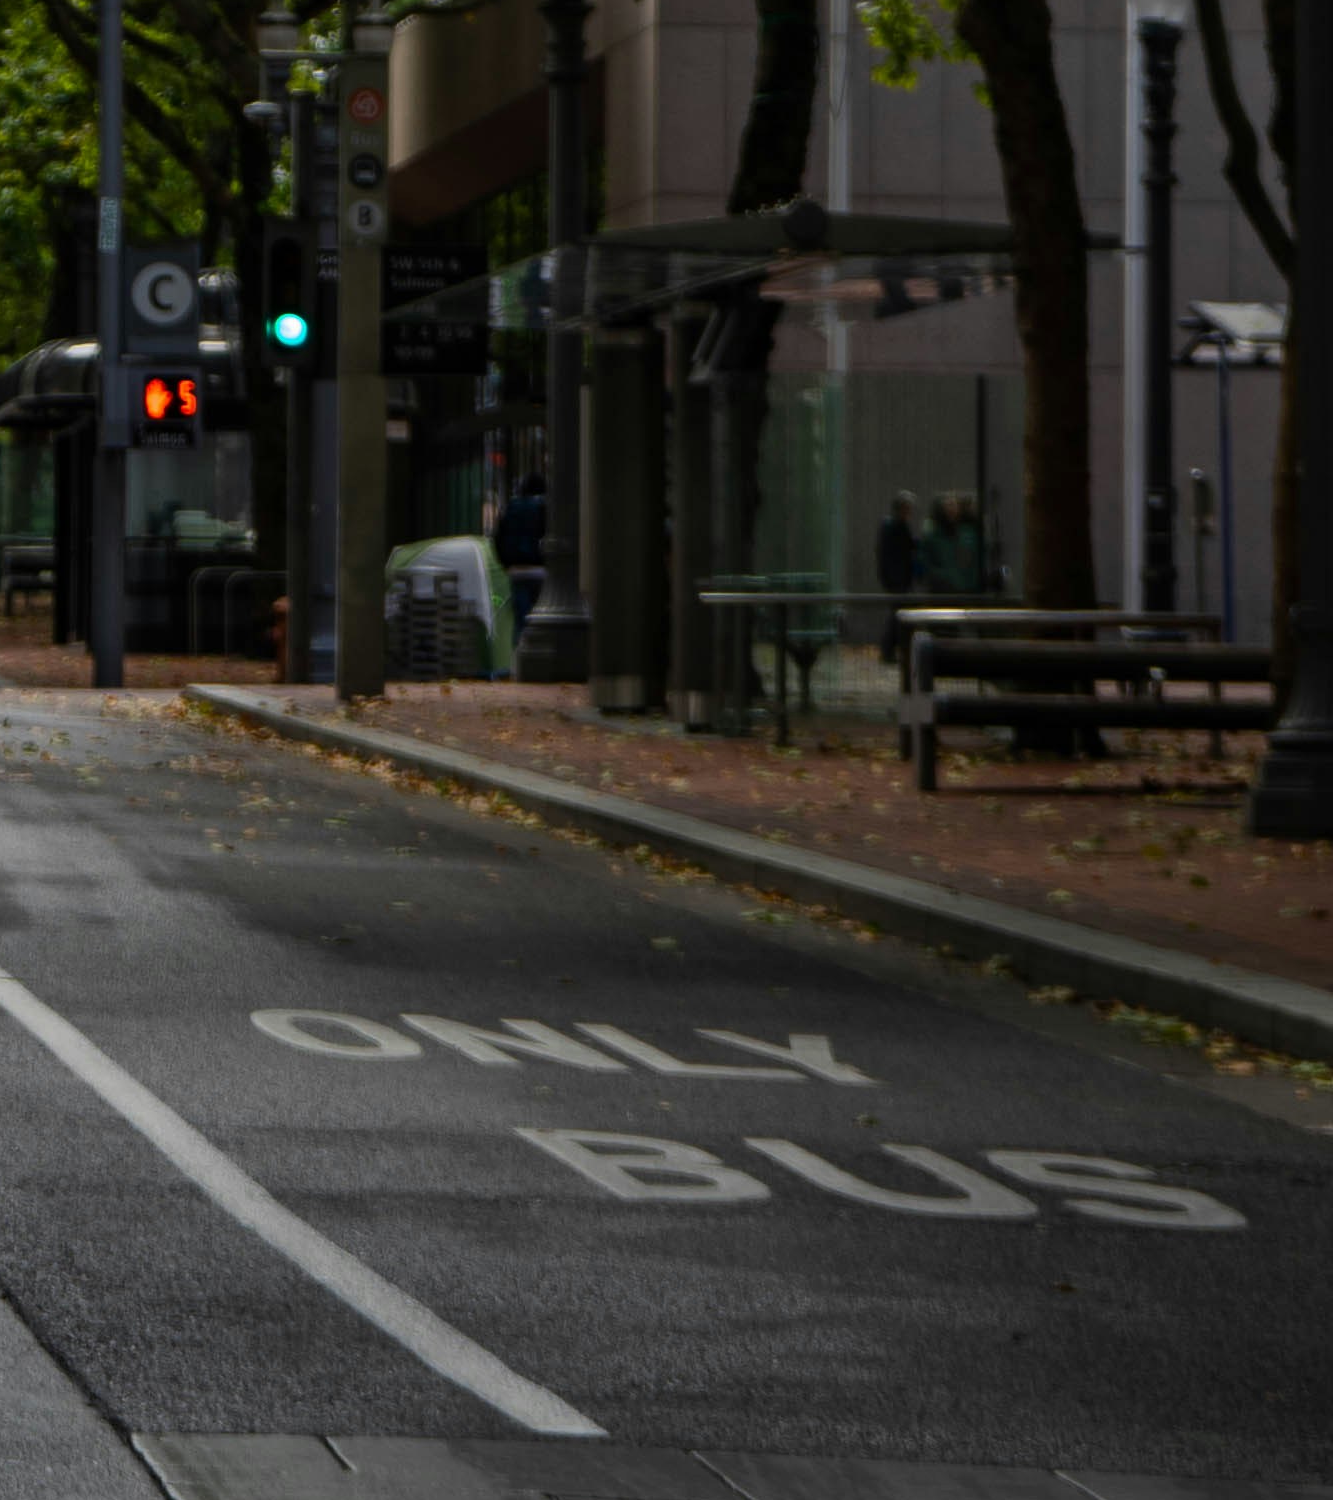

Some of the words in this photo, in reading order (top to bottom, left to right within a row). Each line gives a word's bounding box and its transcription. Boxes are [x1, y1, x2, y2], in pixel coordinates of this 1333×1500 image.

[148, 274, 174, 311] C
[178, 379, 197, 416] 5
[249, 1009, 879, 1087] ONLY
[513, 1127, 1248, 1231] BUS
